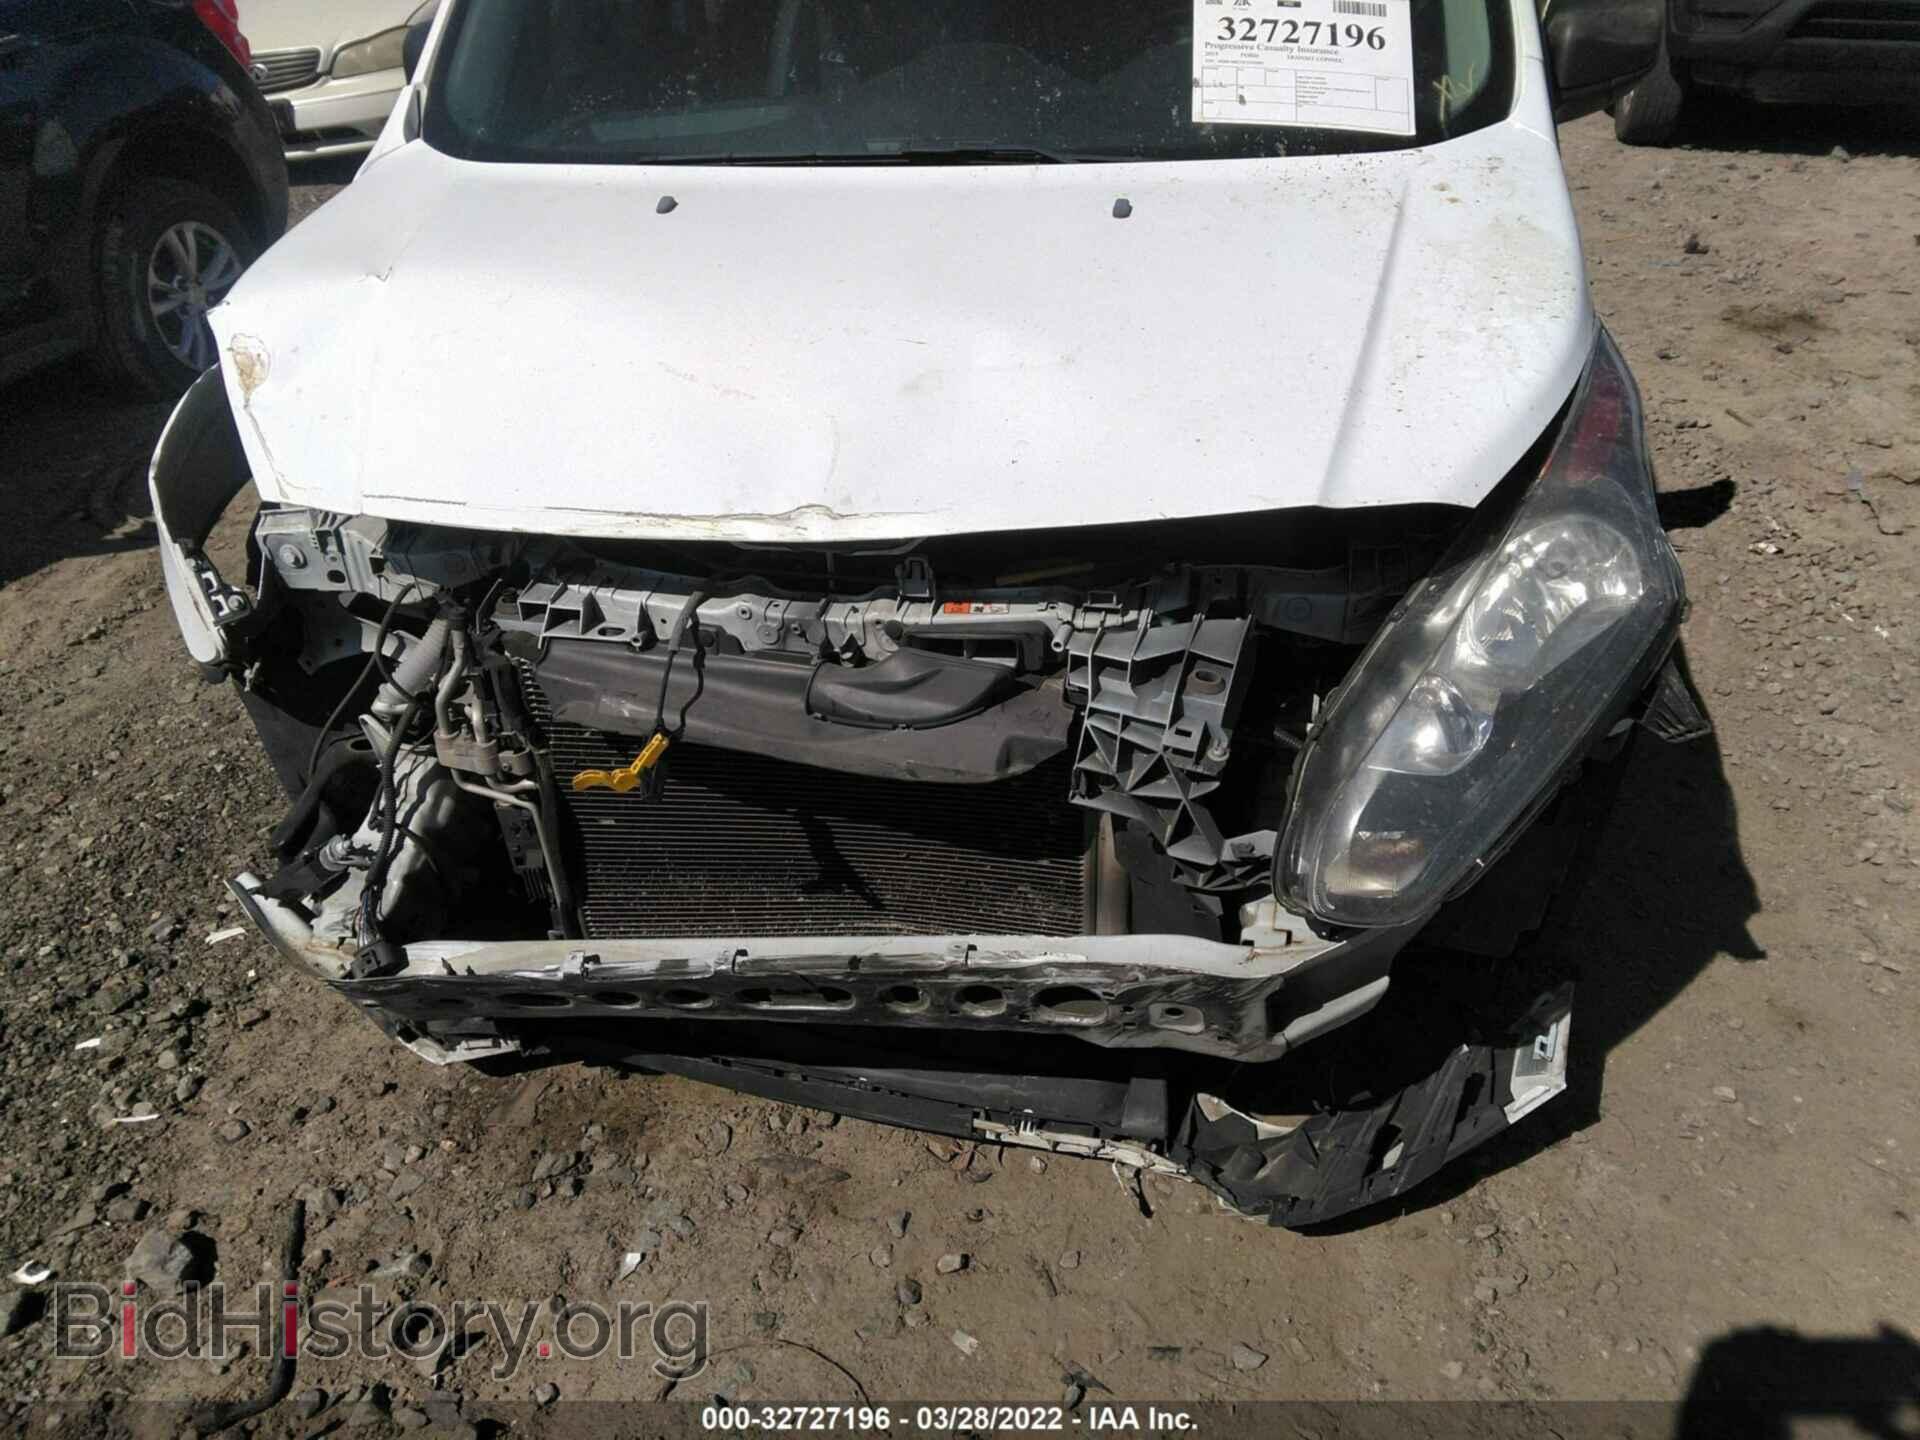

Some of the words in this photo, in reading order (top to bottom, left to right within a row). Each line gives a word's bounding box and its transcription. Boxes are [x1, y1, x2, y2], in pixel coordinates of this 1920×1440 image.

[1217, 16, 1386, 50] 32727196
[1205, 41, 1255, 52] Progressive
[1297, 46, 1339, 55] Insurance
